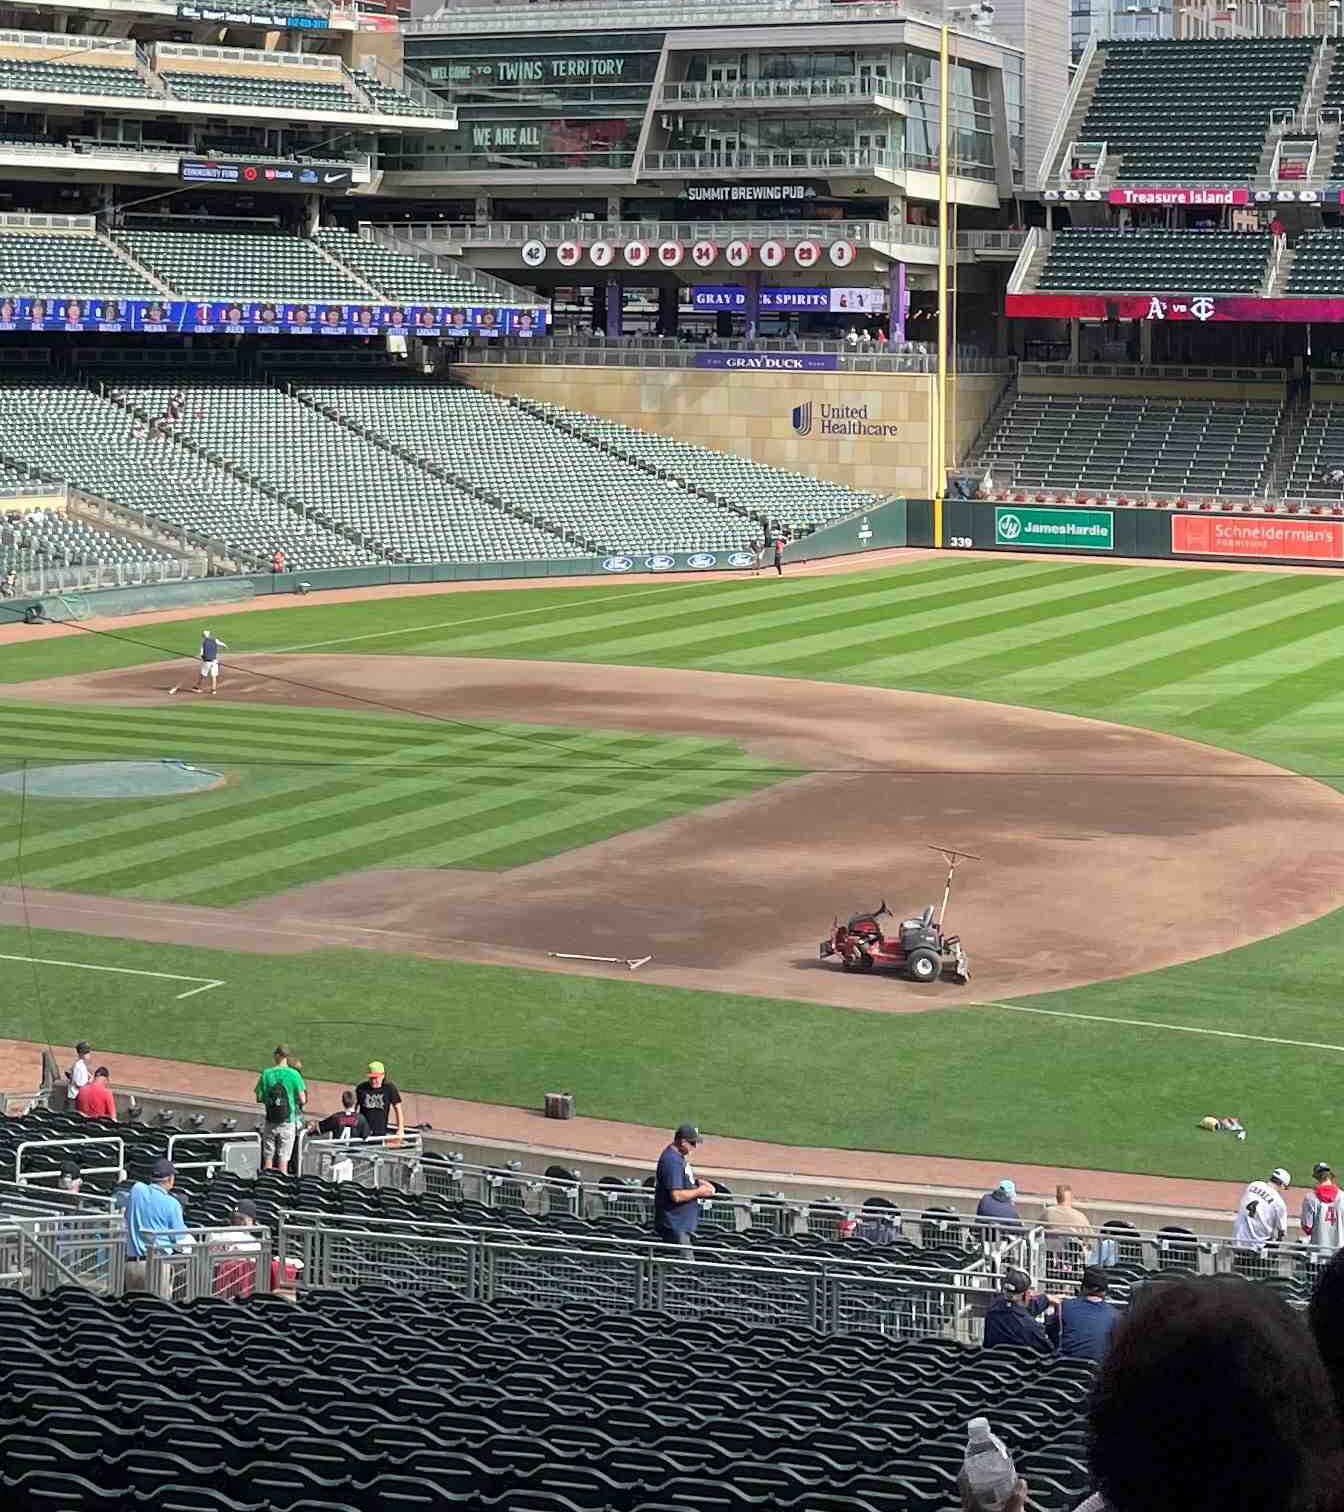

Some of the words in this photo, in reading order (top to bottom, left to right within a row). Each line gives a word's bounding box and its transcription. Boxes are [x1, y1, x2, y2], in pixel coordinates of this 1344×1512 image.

[431, 66, 471, 80] WELCOME
[477, 65, 492, 74] TO
[497, 61, 543, 81] TWINS
[552, 59, 625, 76] TERRITORY
[473, 127, 491, 146] WE
[495, 127, 517, 145] ARE
[519, 127, 540, 145] ALL
[688, 187, 730, 201] SUMMIT
[731, 186, 781, 200] BREWING
[782, 186, 805, 199] PUB
[1123, 191, 1186, 204] Treasure
[1189, 190, 1233, 204] Island
[527, 247, 540, 260] 42
[597, 248, 605, 260] 7
[696, 248, 711, 260] 34
[730, 248, 742, 260] 14
[837, 248, 845, 260] 3
[696, 293, 731, 304] GRAY
[735, 293, 772, 305] DK
[775, 293, 828, 305] SPIRITS
[1171, 305, 1188, 314] vs
[726, 358, 766, 368] GRAY
[766, 358, 803, 368] DUCK
[820, 404, 868, 419] United
[821, 419, 898, 437] Healthcare
[1023, 521, 1109, 538] JamesHardie
[1215, 523, 1335, 543] Schneiderman's
[950, 537, 973, 547] 339
[1324, 1205, 1338, 1226] 4
